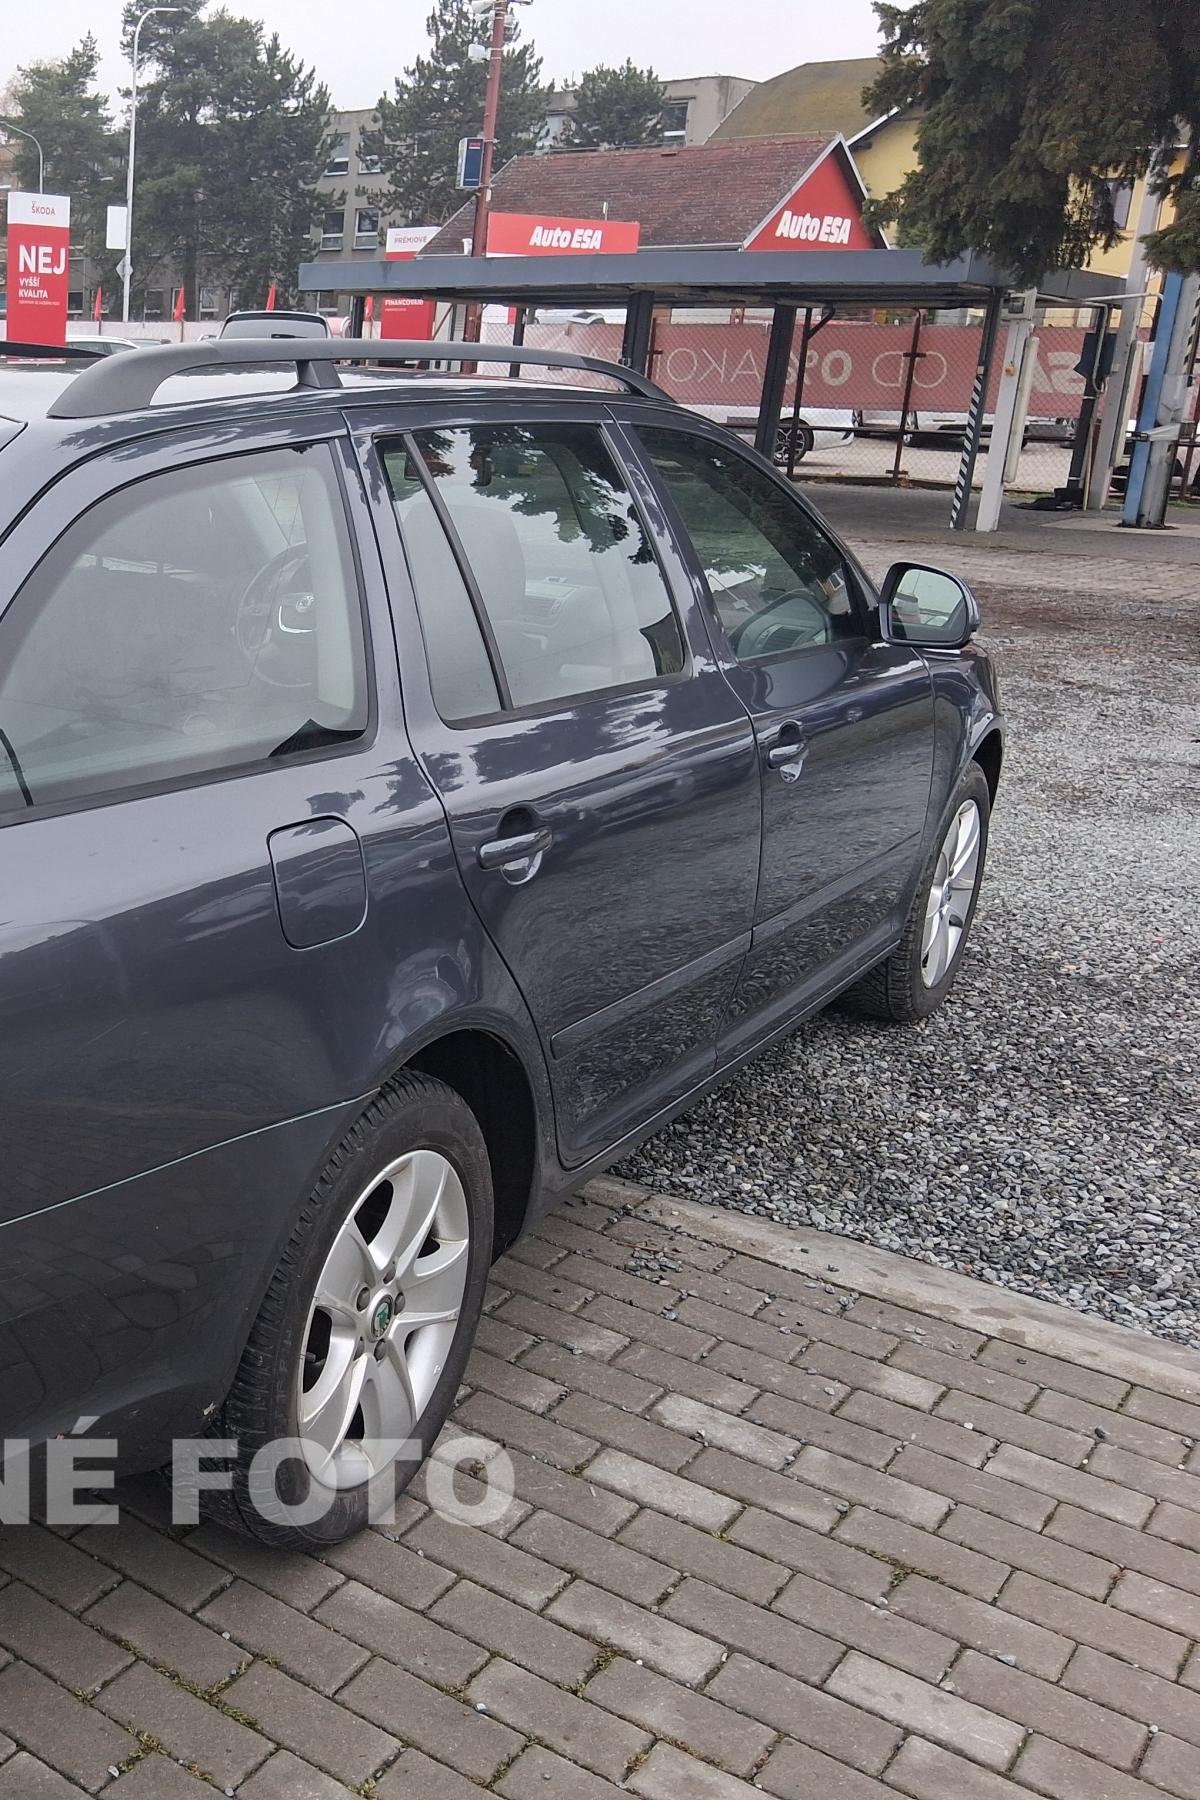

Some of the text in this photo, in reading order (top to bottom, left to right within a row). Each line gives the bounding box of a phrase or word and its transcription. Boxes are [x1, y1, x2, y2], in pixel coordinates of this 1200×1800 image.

[528, 226, 603, 250] Auto ESA
[776, 210, 852, 245] Auto ESA
[18, 244, 67, 275] NEJ
[18, 288, 49, 298] KVALITA
